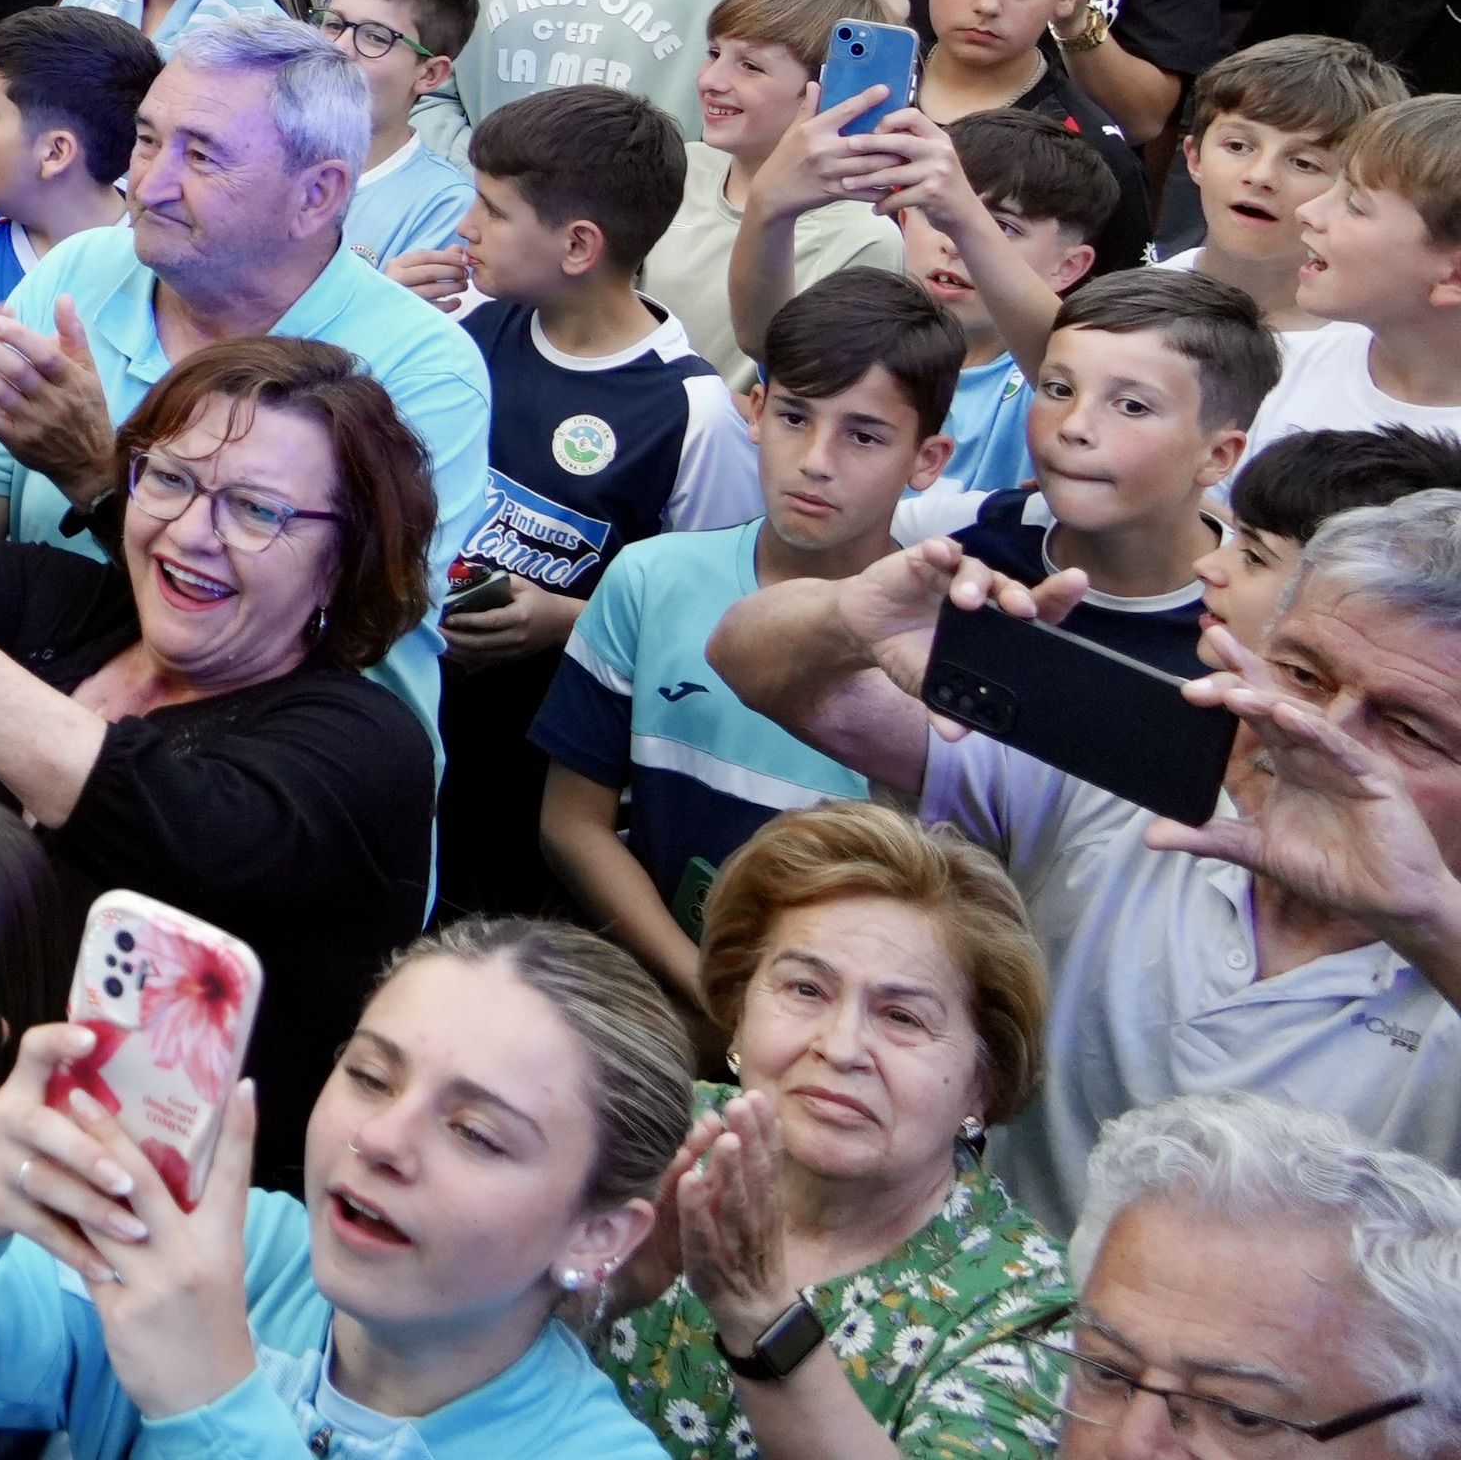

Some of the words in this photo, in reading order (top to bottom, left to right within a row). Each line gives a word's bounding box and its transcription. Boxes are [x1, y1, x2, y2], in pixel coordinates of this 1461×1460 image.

[495, 48, 537, 83] LA
[545, 52, 629, 91] MER
[497, 501, 577, 550] Pinturas
